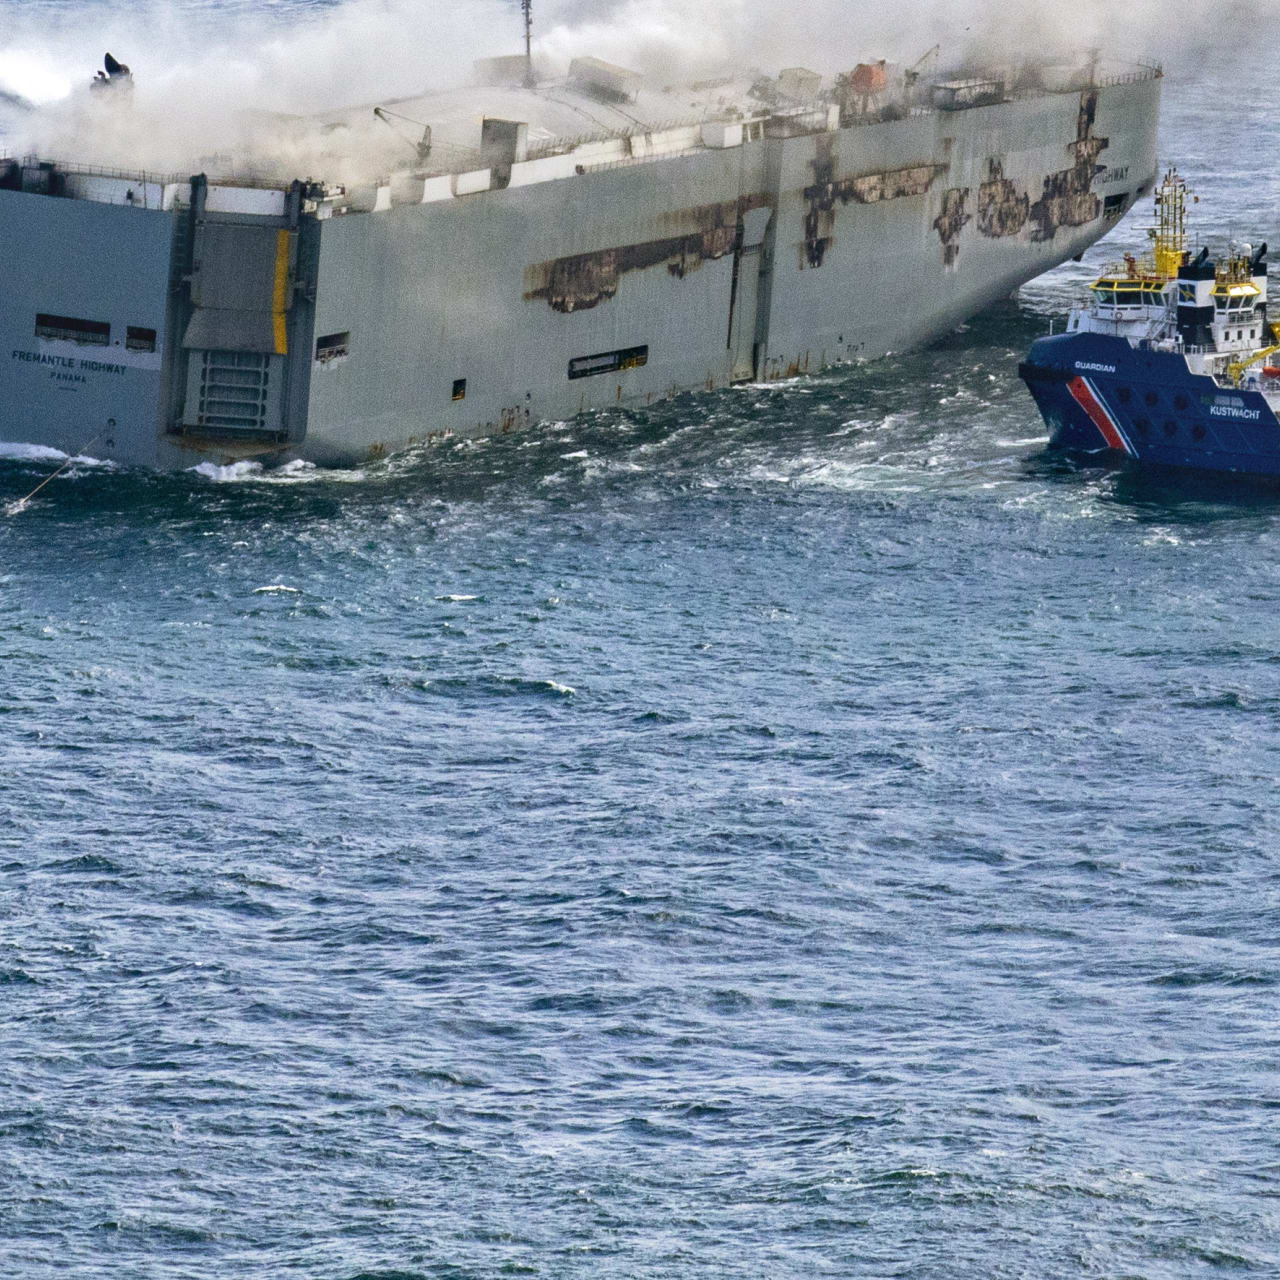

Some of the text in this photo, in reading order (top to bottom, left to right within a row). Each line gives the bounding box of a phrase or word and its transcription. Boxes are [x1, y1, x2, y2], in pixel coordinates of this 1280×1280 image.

[12, 350, 127, 376] FREMANTLE HIGHWAY
[1074, 360, 1116, 373] GUARDIAN
[49, 371, 87, 384] PANAMA
[1210, 405, 1261, 420] KUSTWACHT
